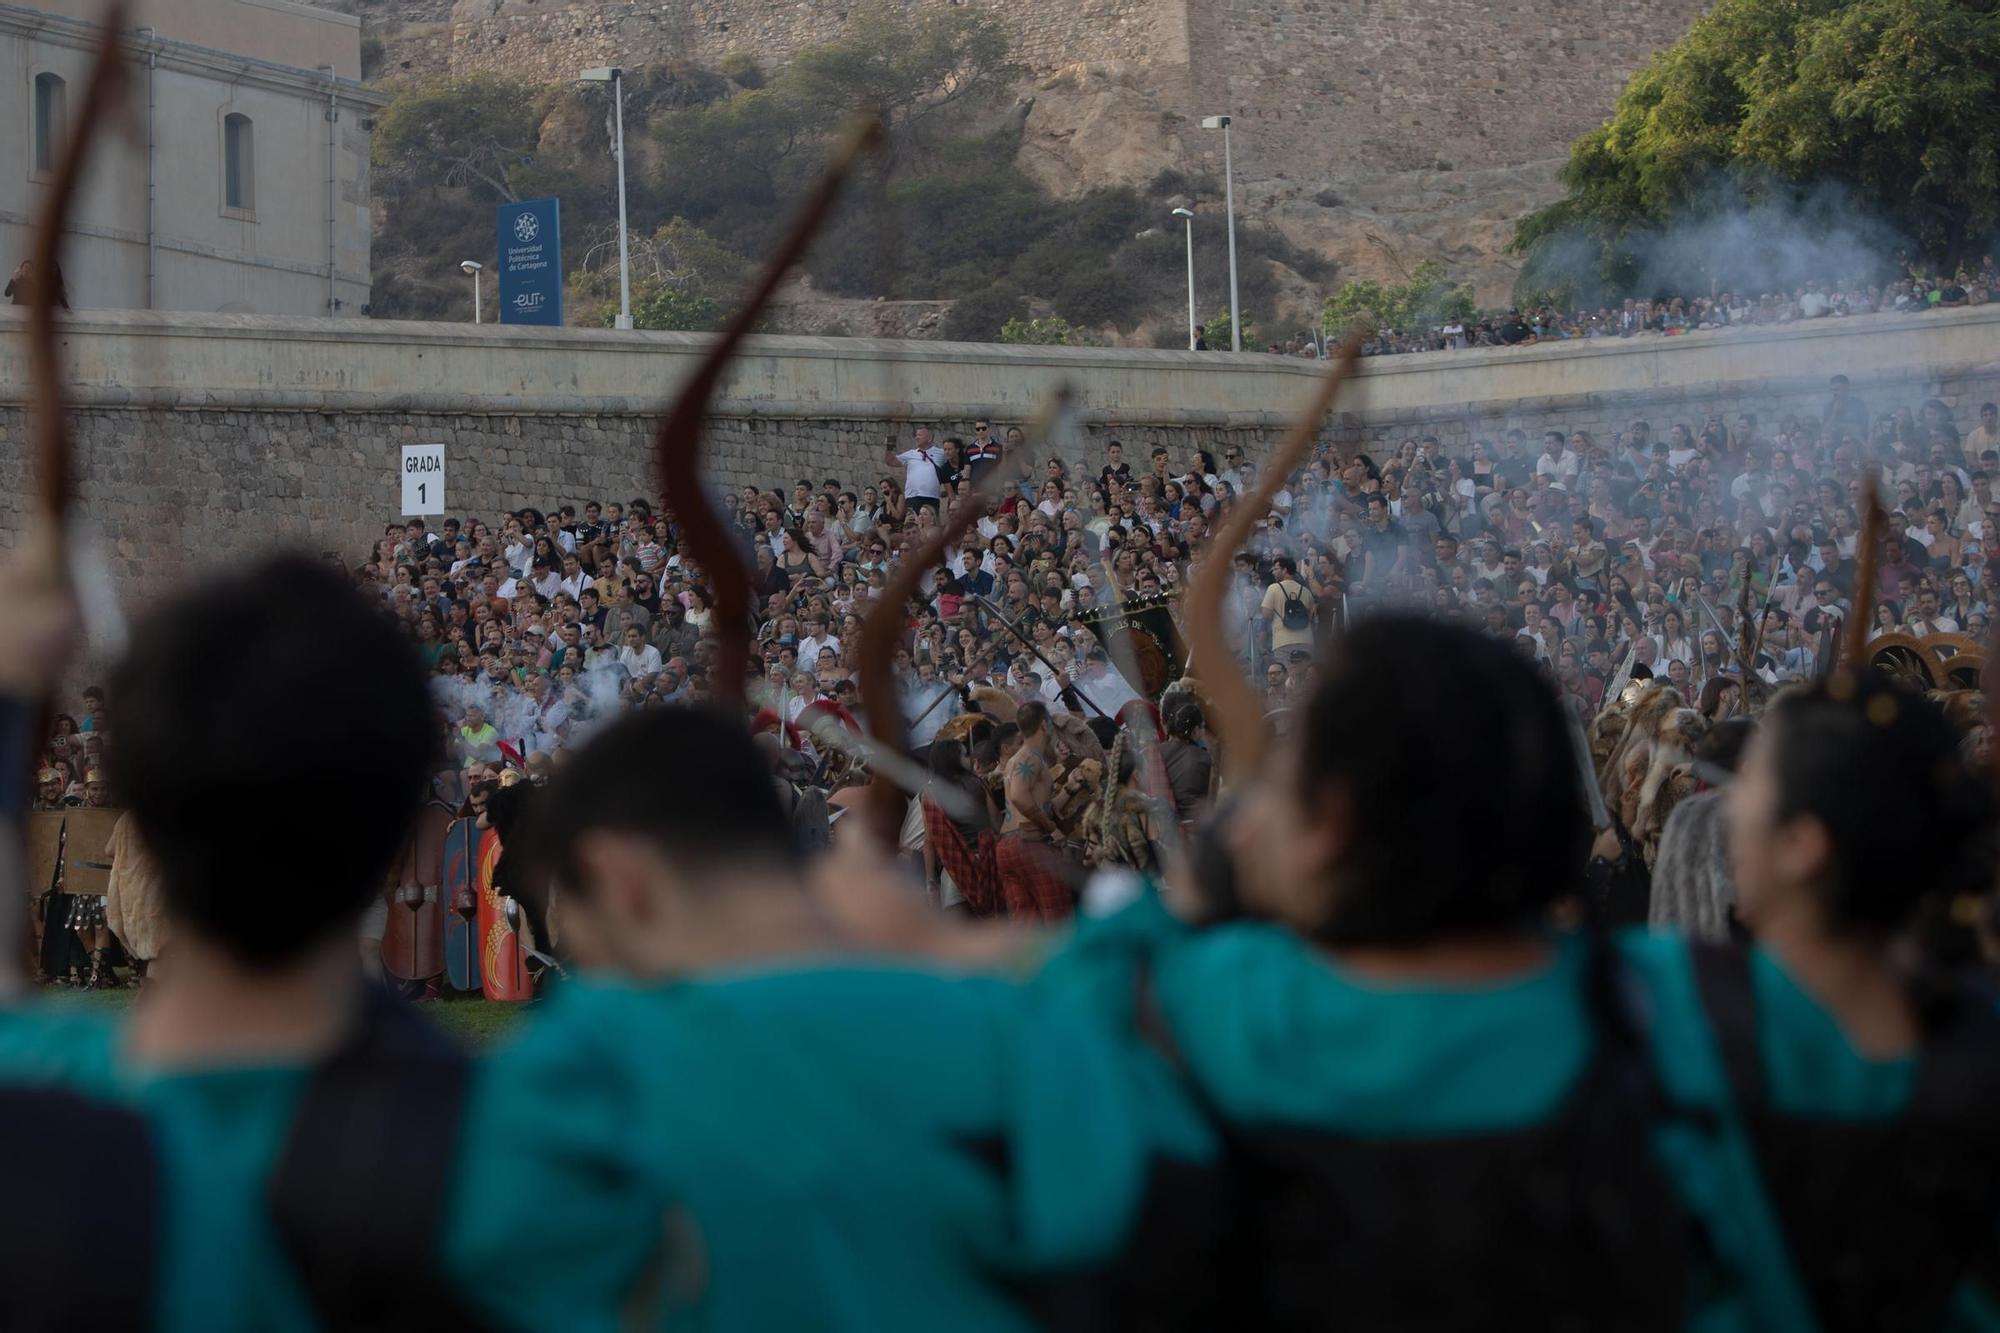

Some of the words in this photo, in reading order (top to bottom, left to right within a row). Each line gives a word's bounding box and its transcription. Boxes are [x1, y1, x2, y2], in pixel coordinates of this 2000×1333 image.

[508, 245, 542, 255] Universidad
[509, 264, 517, 272] de
[517, 261, 547, 270] Cartagena
[405, 455, 441, 473] GRADA
[418, 482, 426, 504] 1
